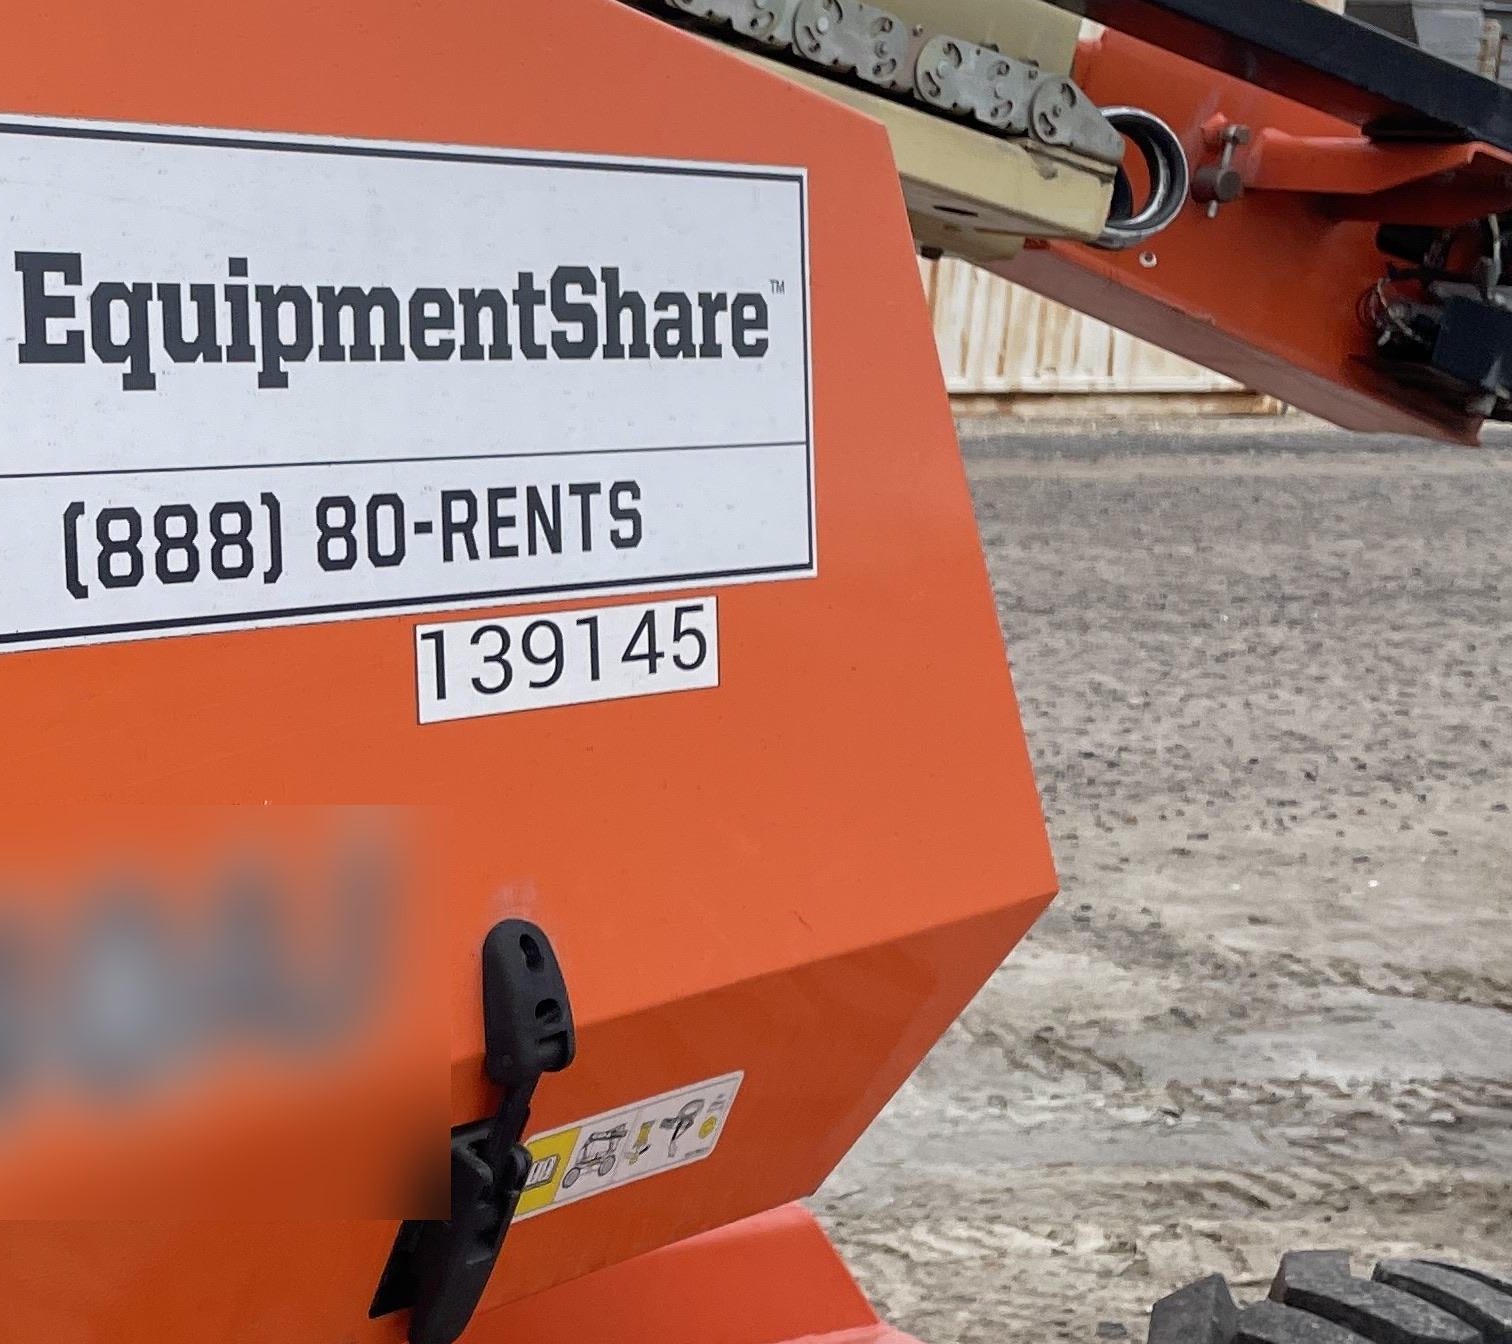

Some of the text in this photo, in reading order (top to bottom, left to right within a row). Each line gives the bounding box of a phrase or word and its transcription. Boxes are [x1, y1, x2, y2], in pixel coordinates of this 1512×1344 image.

[14, 250, 770, 391] EquipmentShare
[63, 480, 645, 600] (888) 80-RENTS
[419, 607, 710, 703] 139145
